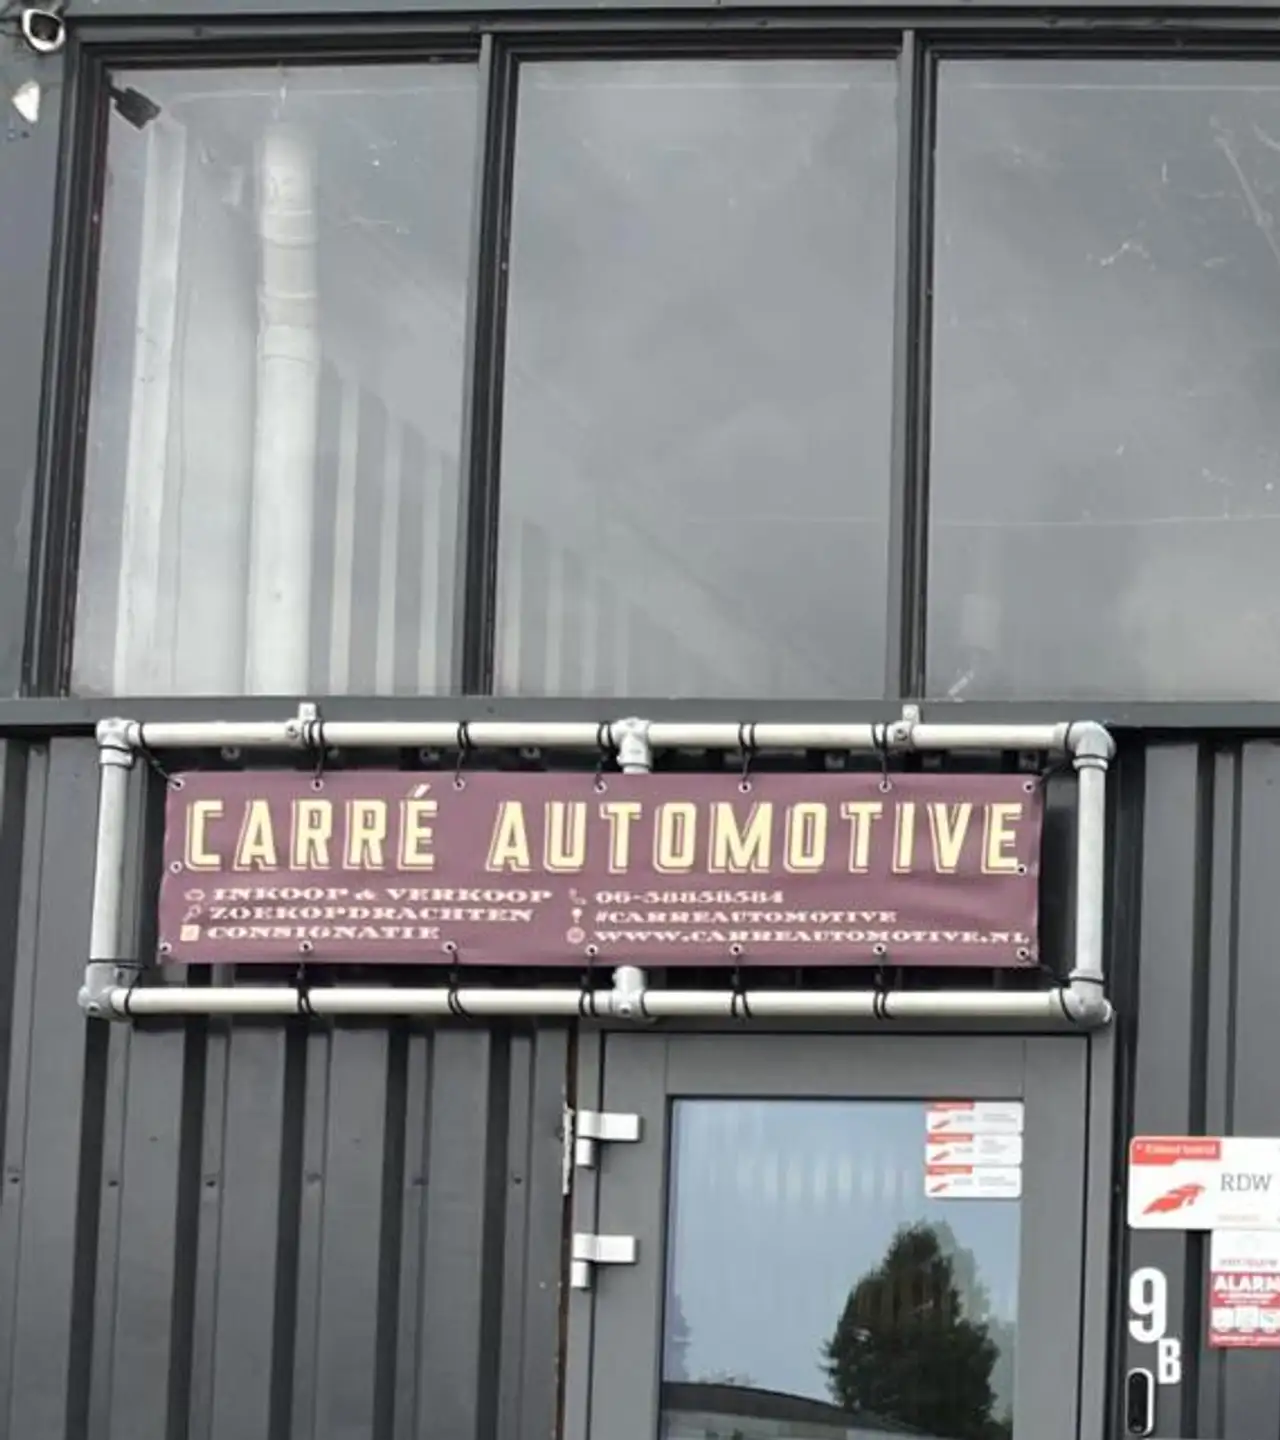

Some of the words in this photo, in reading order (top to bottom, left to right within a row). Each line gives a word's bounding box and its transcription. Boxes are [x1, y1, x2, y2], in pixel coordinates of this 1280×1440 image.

[185, 783, 438, 872] CARRÉ
[486, 799, 1024, 874] AUTOMOTIVE
[212, 887, 349, 902] INKOOP
[386, 889, 553, 903] VERKOOP
[208, 905, 535, 922] ZOEKOPDRACHTEN
[595, 910, 898, 924] #CARREAUTOMOTIVE
[207, 925, 442, 940] CONSIGNATIE
[594, 929, 1031, 944] WWW.CARREAUTOMOTIVE.NL
[1219, 1172, 1273, 1192] RDW
